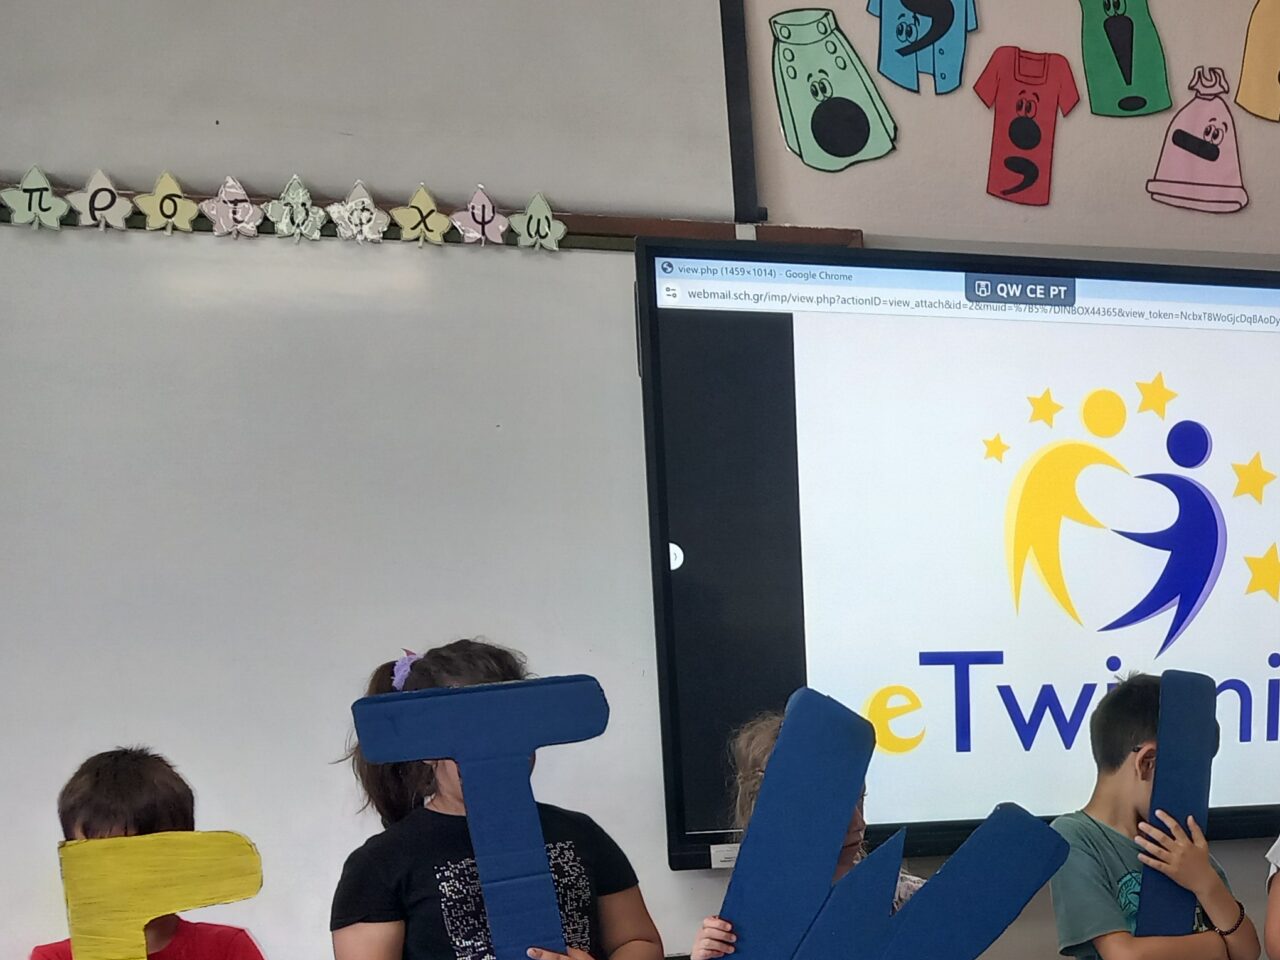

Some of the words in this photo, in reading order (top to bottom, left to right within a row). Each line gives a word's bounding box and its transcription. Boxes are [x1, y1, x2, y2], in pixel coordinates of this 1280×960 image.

[678, 264, 719, 279] view.php
[785, 269, 818, 283] Google
[819, 270, 853, 282] Chrome
[996, 282, 1022, 300] QW
[1025, 284, 1045, 299] CE
[1048, 285, 1067, 300] PT
